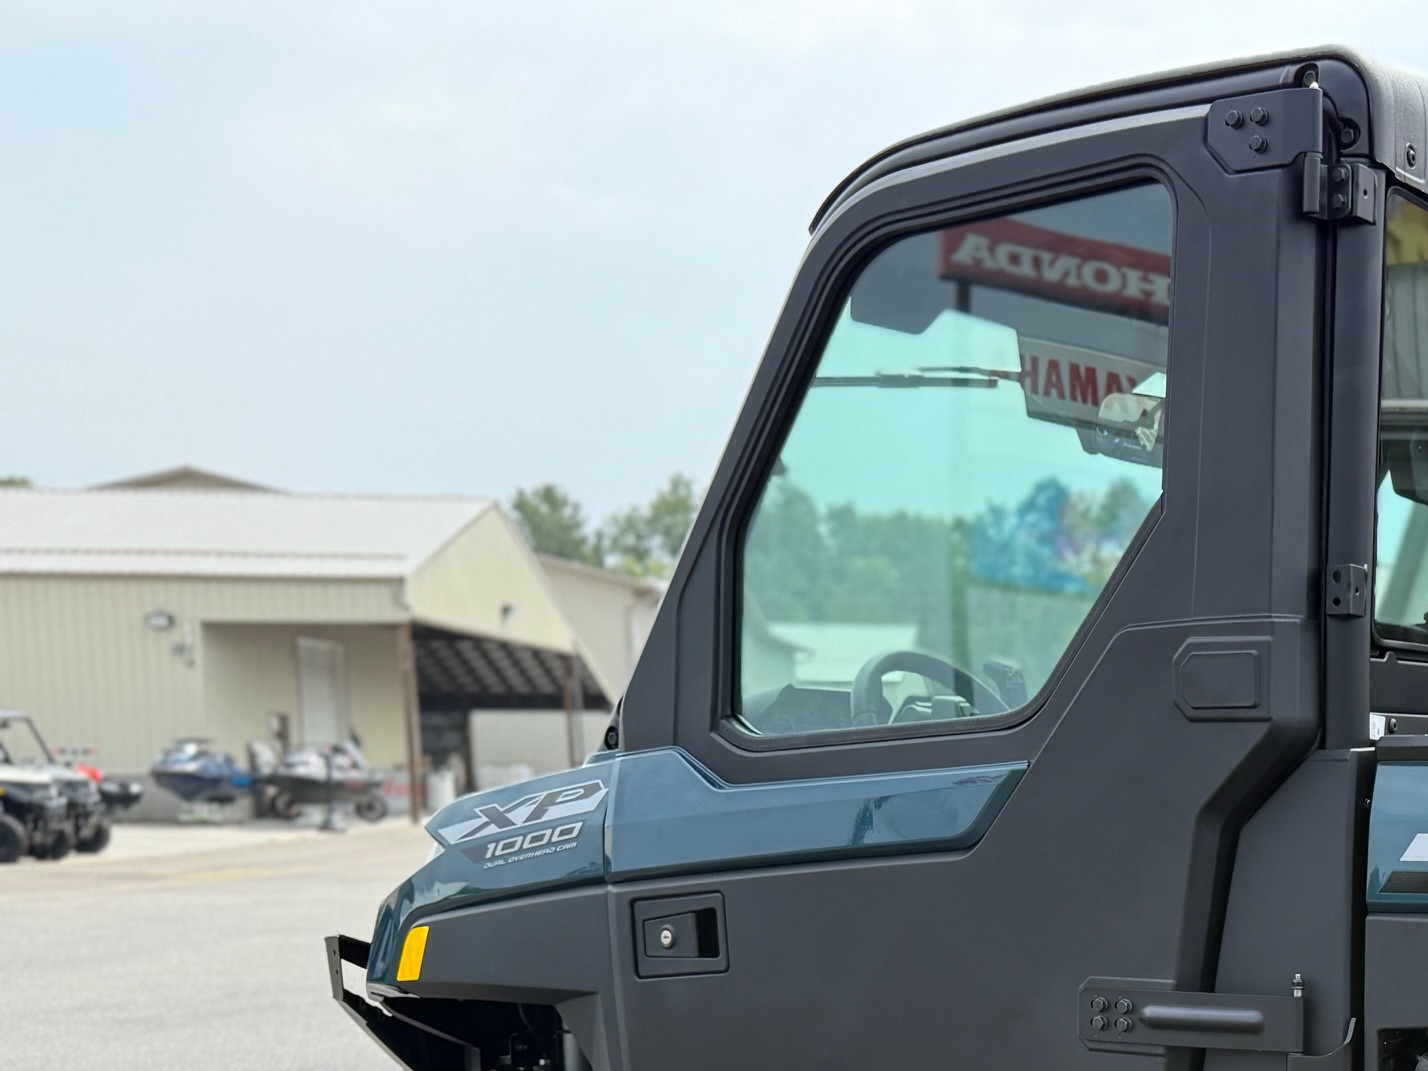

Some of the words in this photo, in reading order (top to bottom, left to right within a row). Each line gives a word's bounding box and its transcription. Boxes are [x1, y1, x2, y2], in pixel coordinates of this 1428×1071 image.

[453, 779, 605, 844] XP
[483, 860, 507, 870] DUAL
[508, 846, 556, 863] OVERHEAD
[556, 841, 578, 852] CAM
[485, 822, 583, 859] 1000
